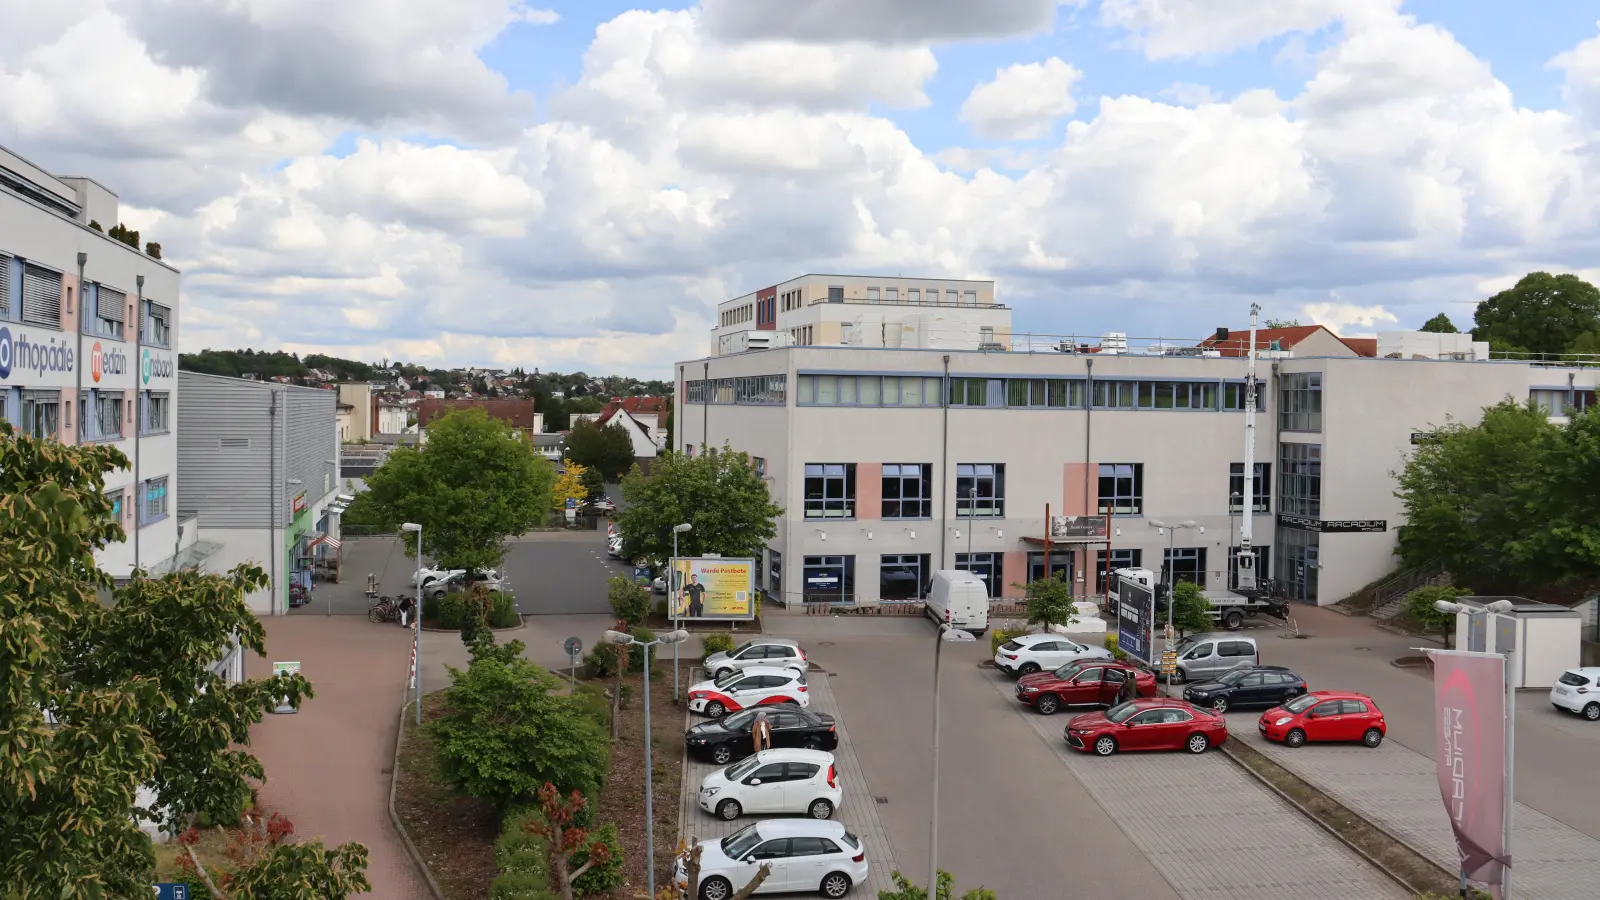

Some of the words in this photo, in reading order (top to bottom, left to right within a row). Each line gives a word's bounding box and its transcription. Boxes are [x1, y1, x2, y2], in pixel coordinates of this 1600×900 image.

[91, 345, 127, 378] medizin
[142, 351, 174, 380] ansbach
[1281, 515, 1322, 528] ARCADIUM
